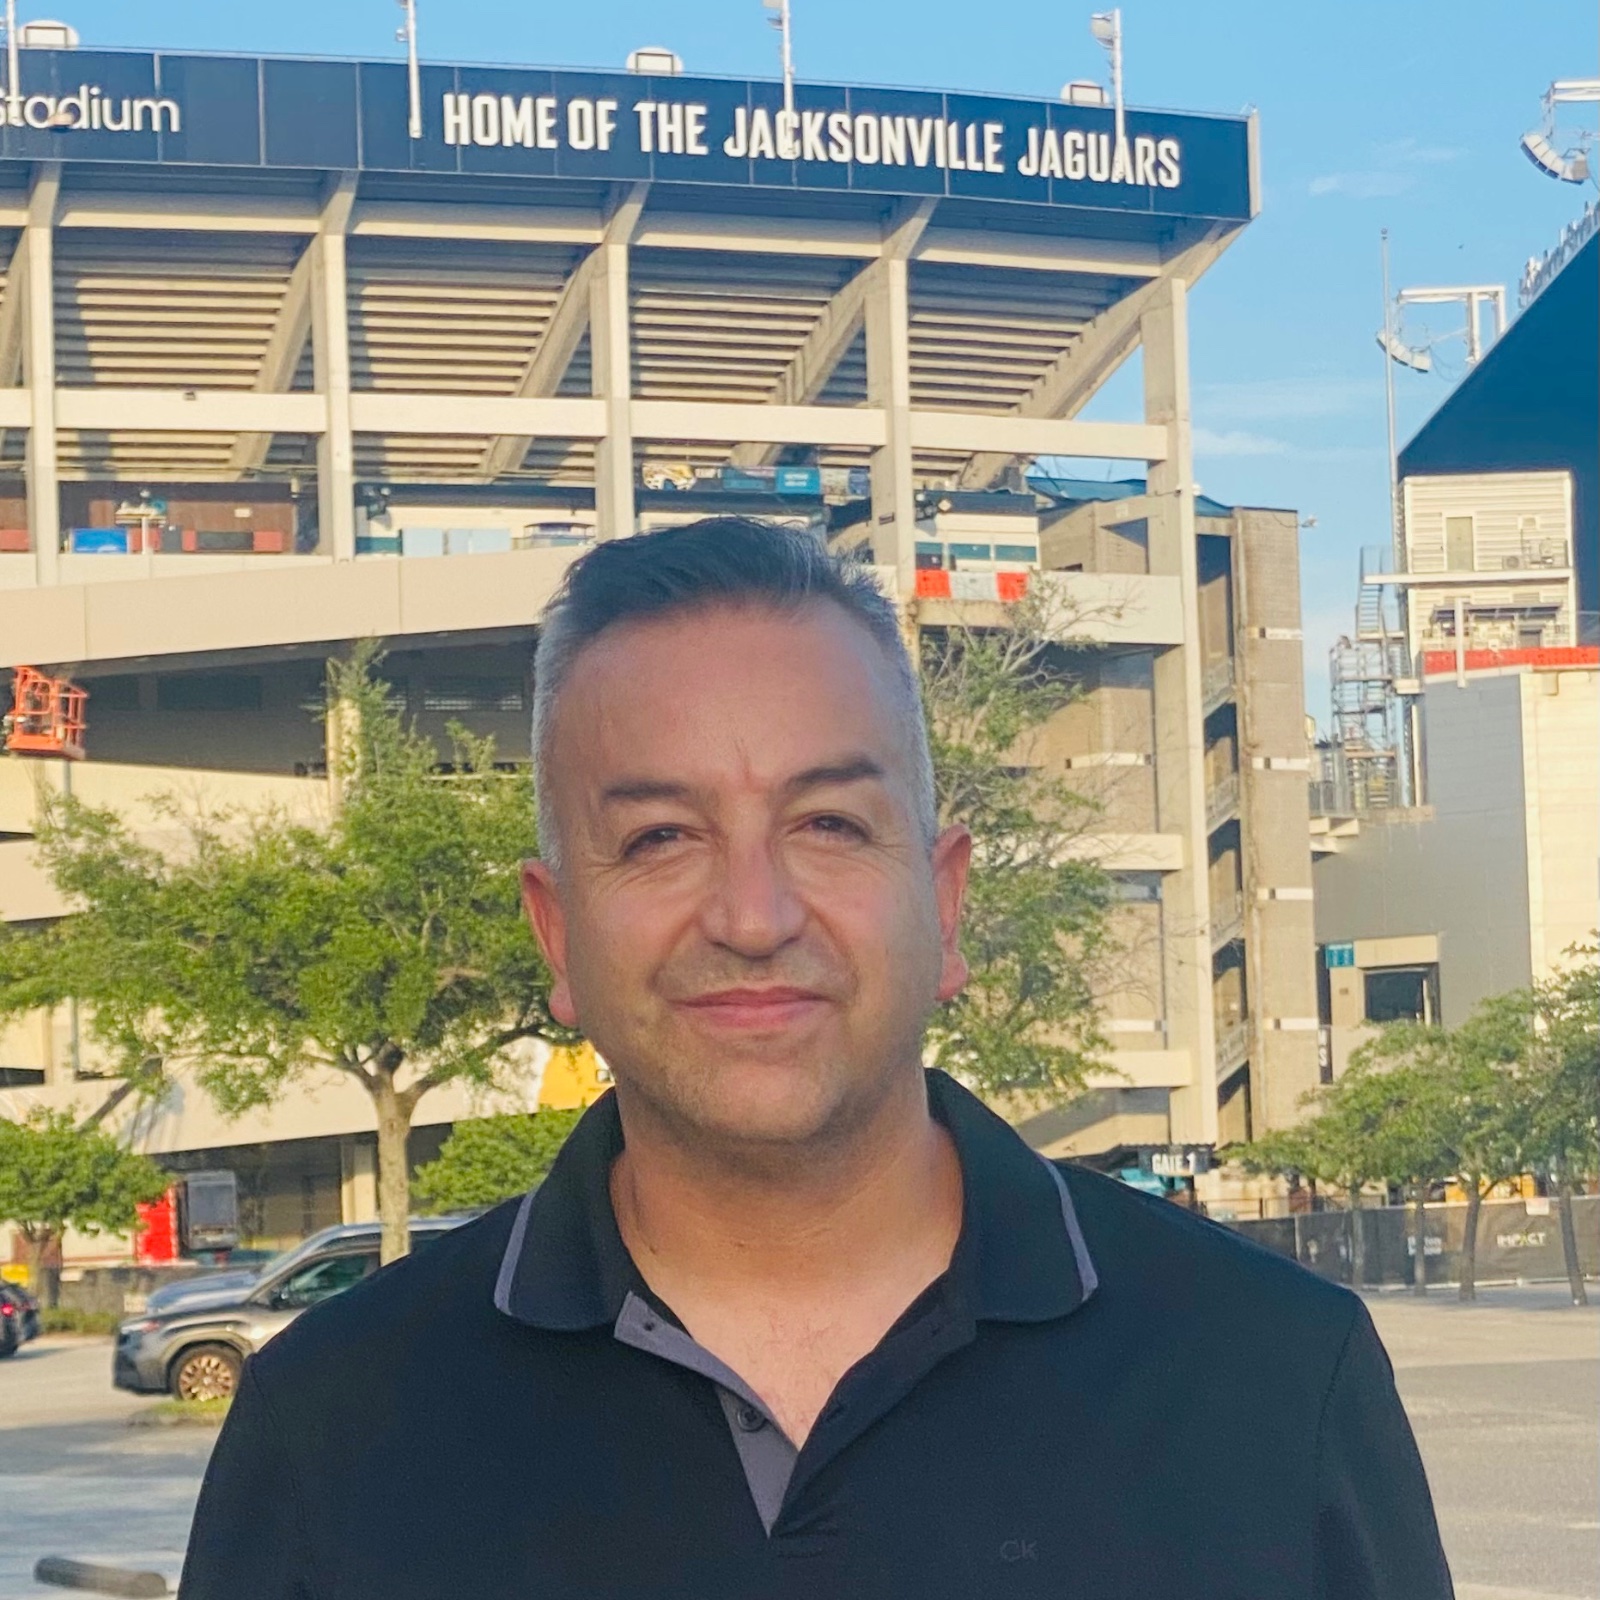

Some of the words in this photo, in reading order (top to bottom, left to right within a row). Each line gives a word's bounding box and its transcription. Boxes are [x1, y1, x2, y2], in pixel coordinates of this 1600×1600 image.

[443, 93, 558, 150] HOME
[567, 98, 618, 152] OF
[632, 101, 709, 156] THE
[722, 105, 1005, 175] JACKSONVILLE
[1017, 127, 1181, 189] JAGUARS
[1152, 1152, 1184, 1176] GATE
[1186, 1151, 1197, 1175] 1
